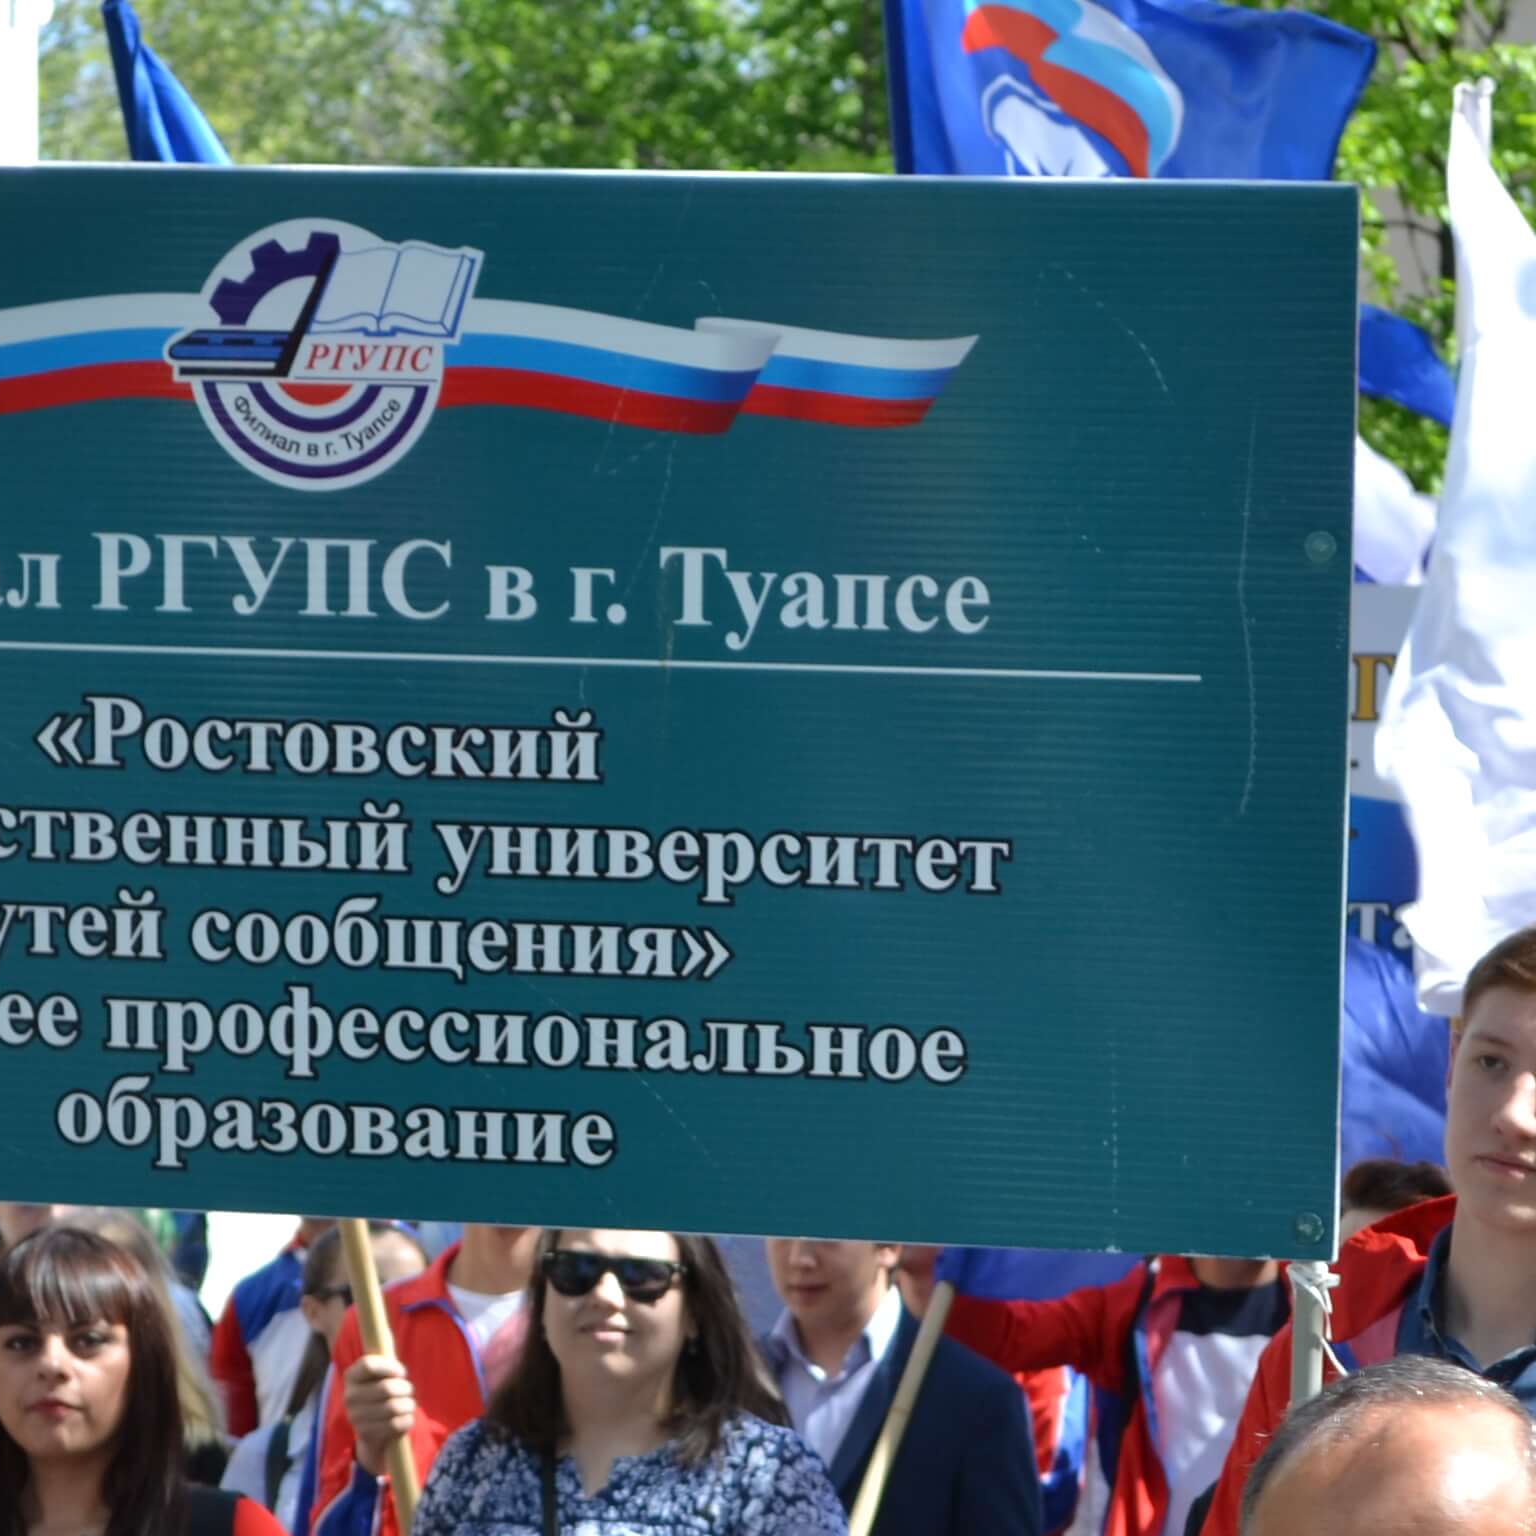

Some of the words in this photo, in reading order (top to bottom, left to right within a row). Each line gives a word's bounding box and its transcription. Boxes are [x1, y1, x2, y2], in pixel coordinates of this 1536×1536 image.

[304, 344, 433, 373] РГУПС
[234, 394, 301, 455] Филиал
[307, 443, 319, 457] в
[325, 443, 338, 457] г.
[341, 398, 401, 452] Туапсе
[92, 531, 452, 620] РГУПС
[485, 564, 539, 622] в
[569, 566, 628, 625] г.
[659, 546, 991, 651] Туапсе
[34, 693, 602, 781] «Ростовский
[432, 820, 1011, 903] университет
[190, 895, 732, 982] сообщения»
[104, 984, 967, 1083] профессиональное
[56, 1074, 616, 1170] образование
